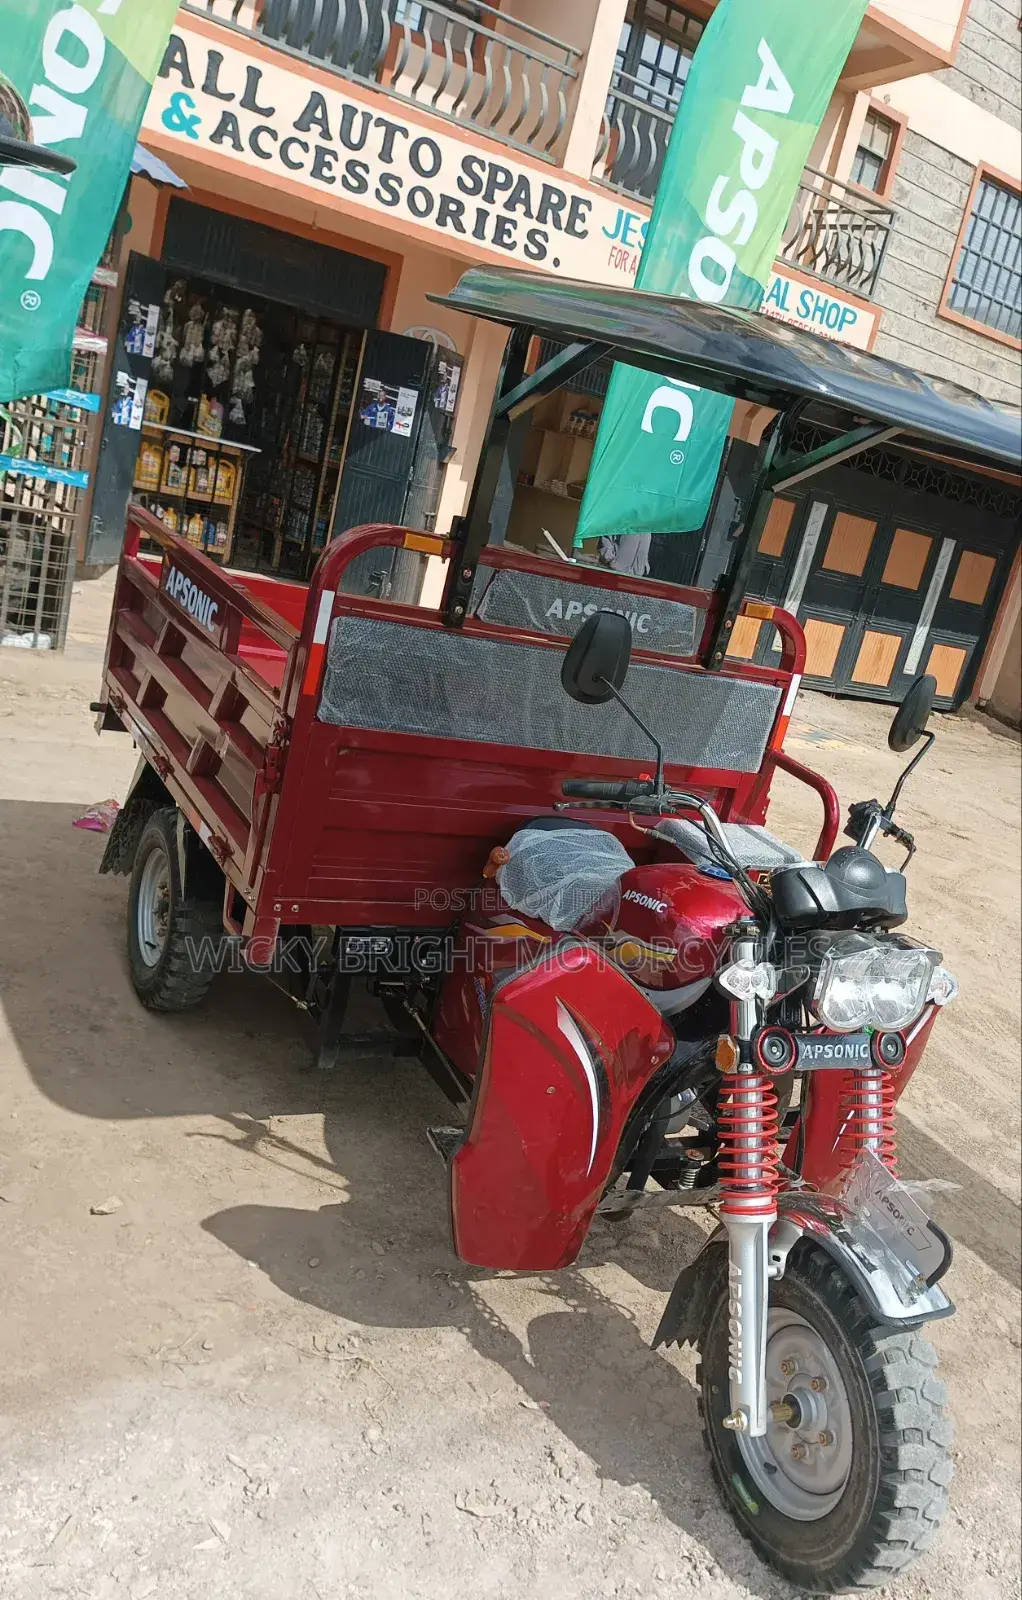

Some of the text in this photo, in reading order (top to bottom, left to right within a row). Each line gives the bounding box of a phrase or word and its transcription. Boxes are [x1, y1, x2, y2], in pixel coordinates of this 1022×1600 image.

[0, 0, 118, 281] ONIC
[158, 34, 592, 239] ALL AUTO SPARE
[161, 92, 561, 268] & ACCESSORIES.
[608, 245, 629, 272] FOR
[762, 277, 790, 312] AL
[796, 289, 858, 332] SHOP
[165, 565, 218, 632] APSONIC
[545, 598, 652, 634] APSIC
[622, 889, 668, 913] APSONIC
[802, 1043, 869, 1060] APSONIC
